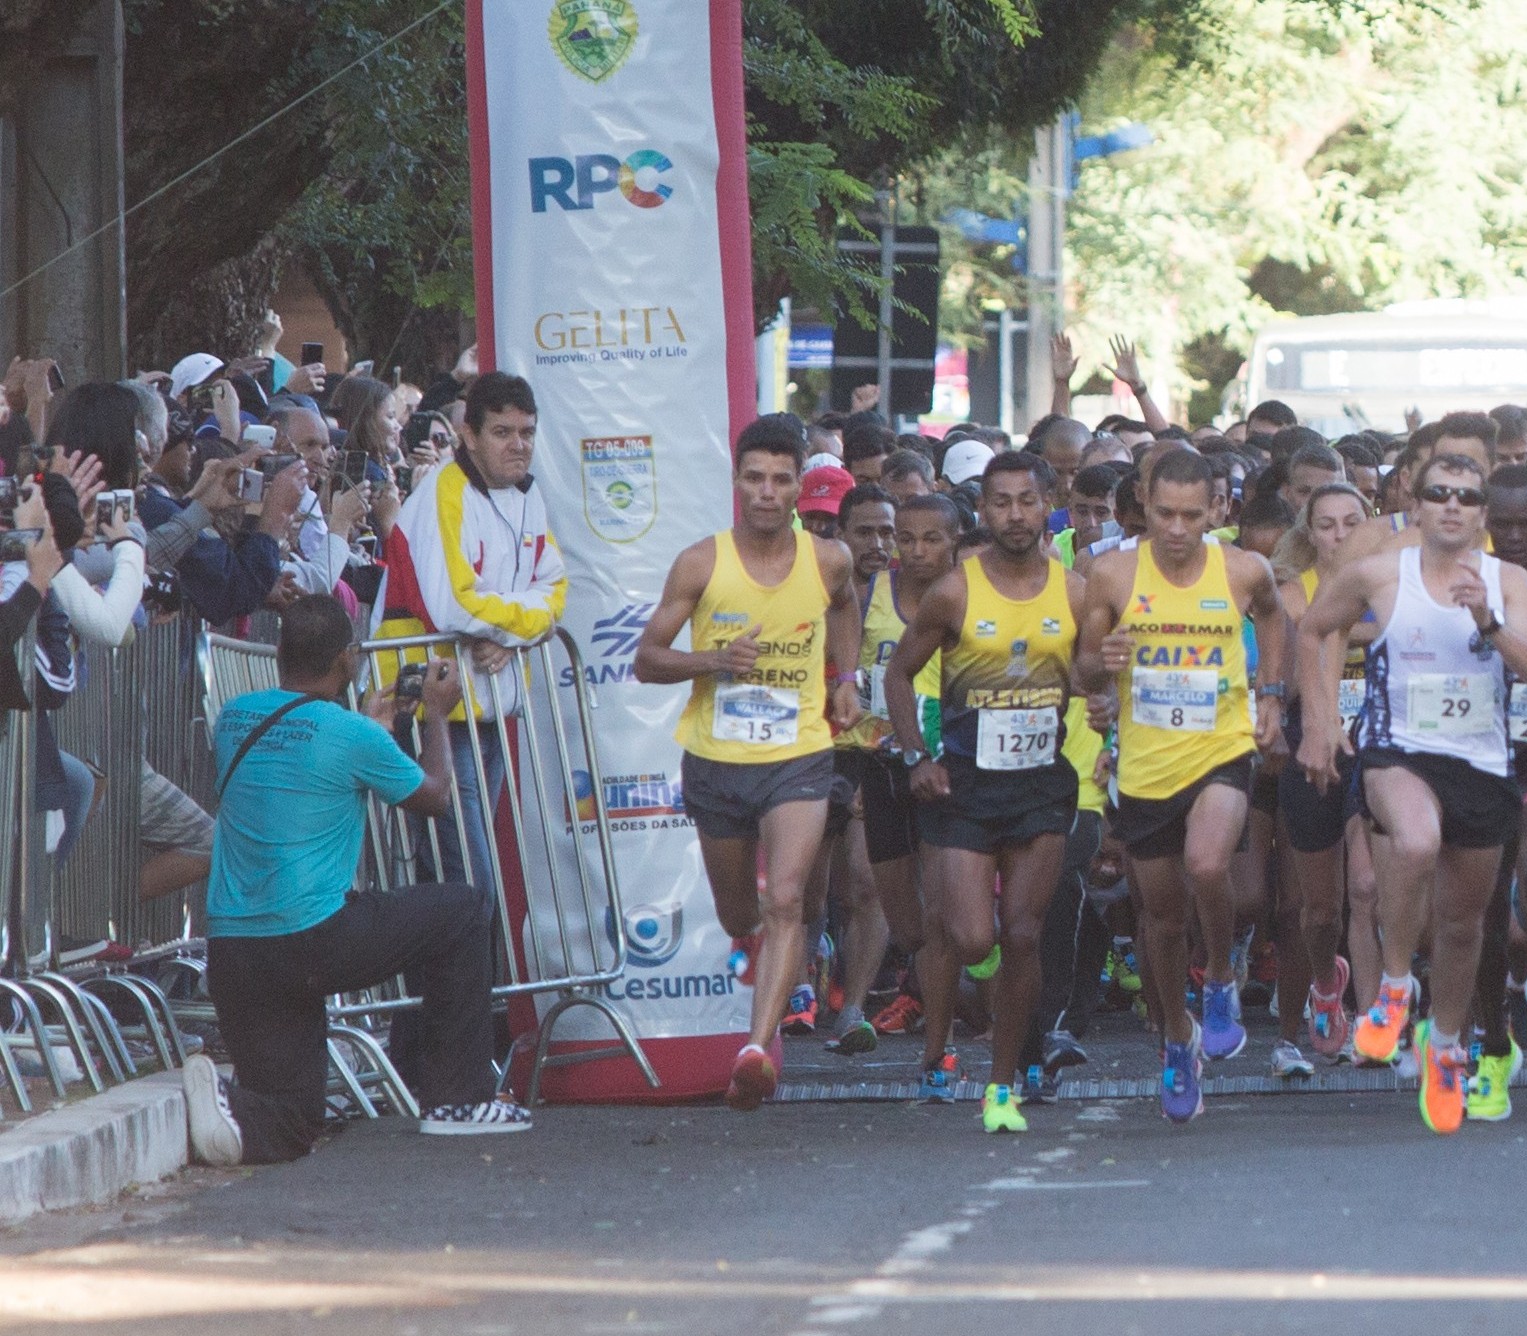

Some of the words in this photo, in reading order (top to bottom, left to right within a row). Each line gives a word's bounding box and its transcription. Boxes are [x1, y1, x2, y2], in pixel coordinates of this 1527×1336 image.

[528, 149, 674, 213] RPC
[534, 307, 686, 351] GELITA
[536, 353, 596, 366] Improving
[600, 349, 646, 363] Quality
[650, 348, 662, 358] of
[665, 346, 688, 358] Life
[1136, 645, 1225, 666] CAIXA
[1150, 690, 1207, 703] MARCELO
[1170, 708, 1184, 727] 8
[1441, 698, 1471, 717] 29
[748, 721, 772, 741] 15
[997, 731, 1049, 753] 1270
[651, 819, 669, 829] DA
